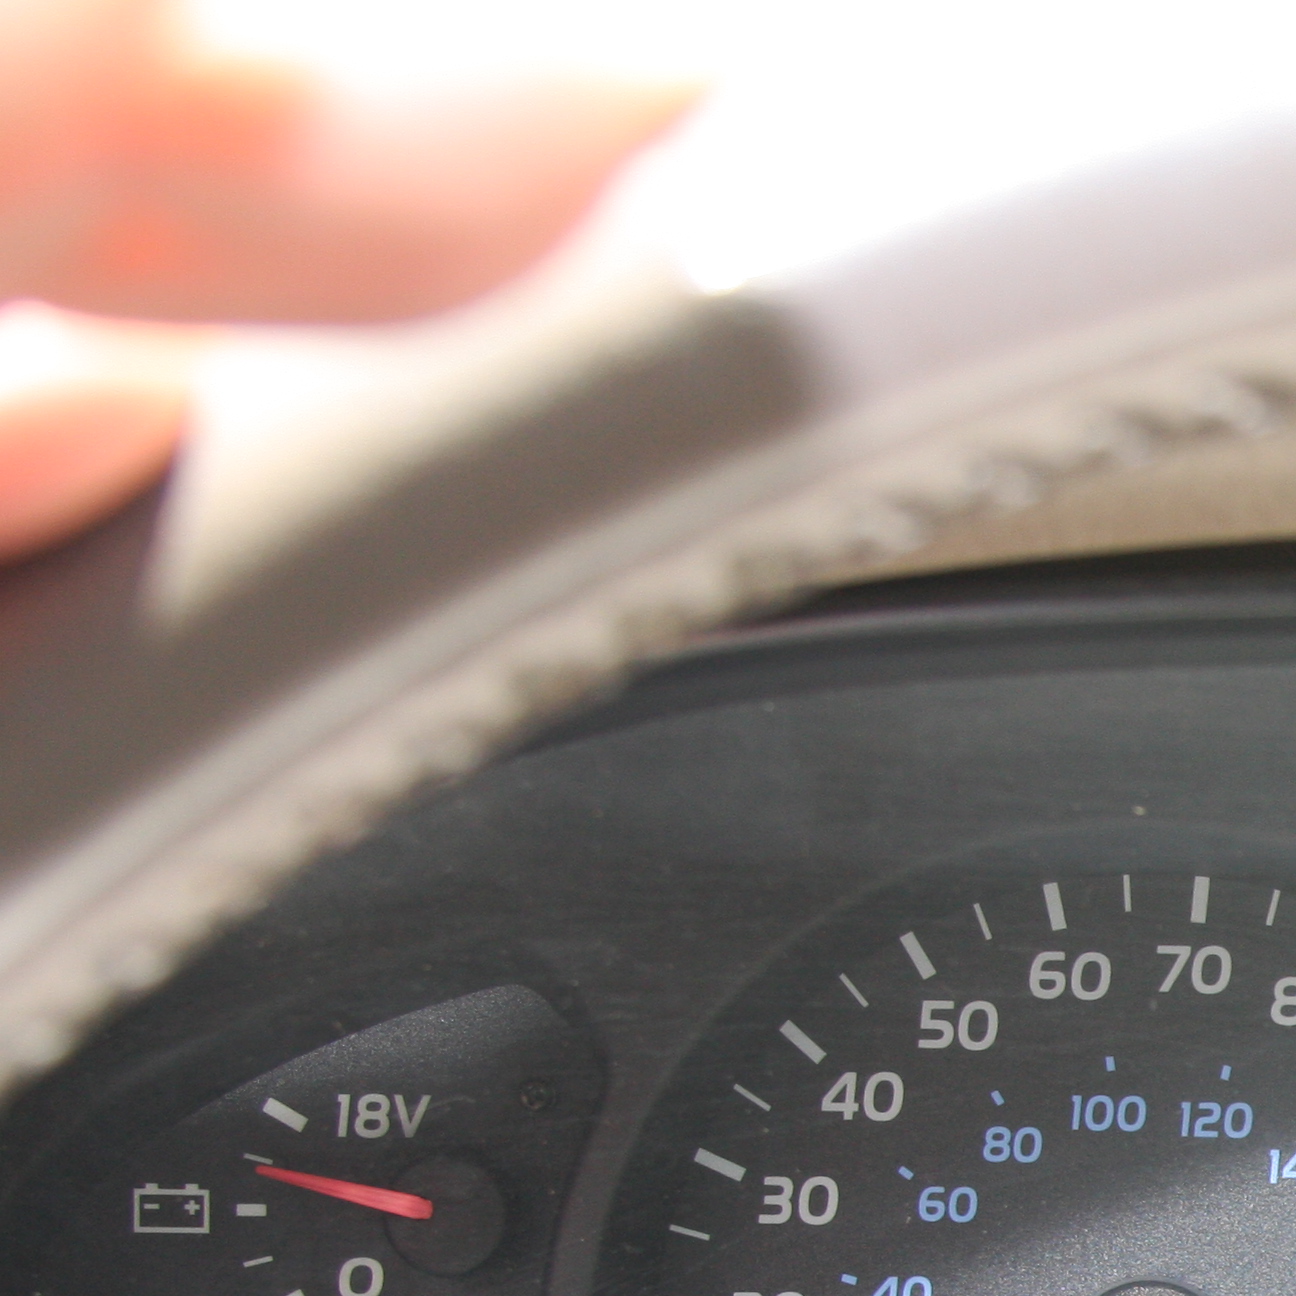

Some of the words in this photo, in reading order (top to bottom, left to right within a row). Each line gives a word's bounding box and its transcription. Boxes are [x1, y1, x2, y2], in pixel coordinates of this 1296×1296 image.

[1029, 951, 1111, 1000] 60
[1157, 945, 1231, 994] 70
[918, 1000, 998, 1050] 50
[337, 1093, 430, 1138] 18V
[821, 1072, 903, 1121] 40
[1072, 1095, 1146, 1132] 100
[1181, 1102, 1253, 1138] 120
[983, 1126, 1042, 1163] 80
[758, 1176, 838, 1225] 30
[918, 1186, 977, 1222] 60
